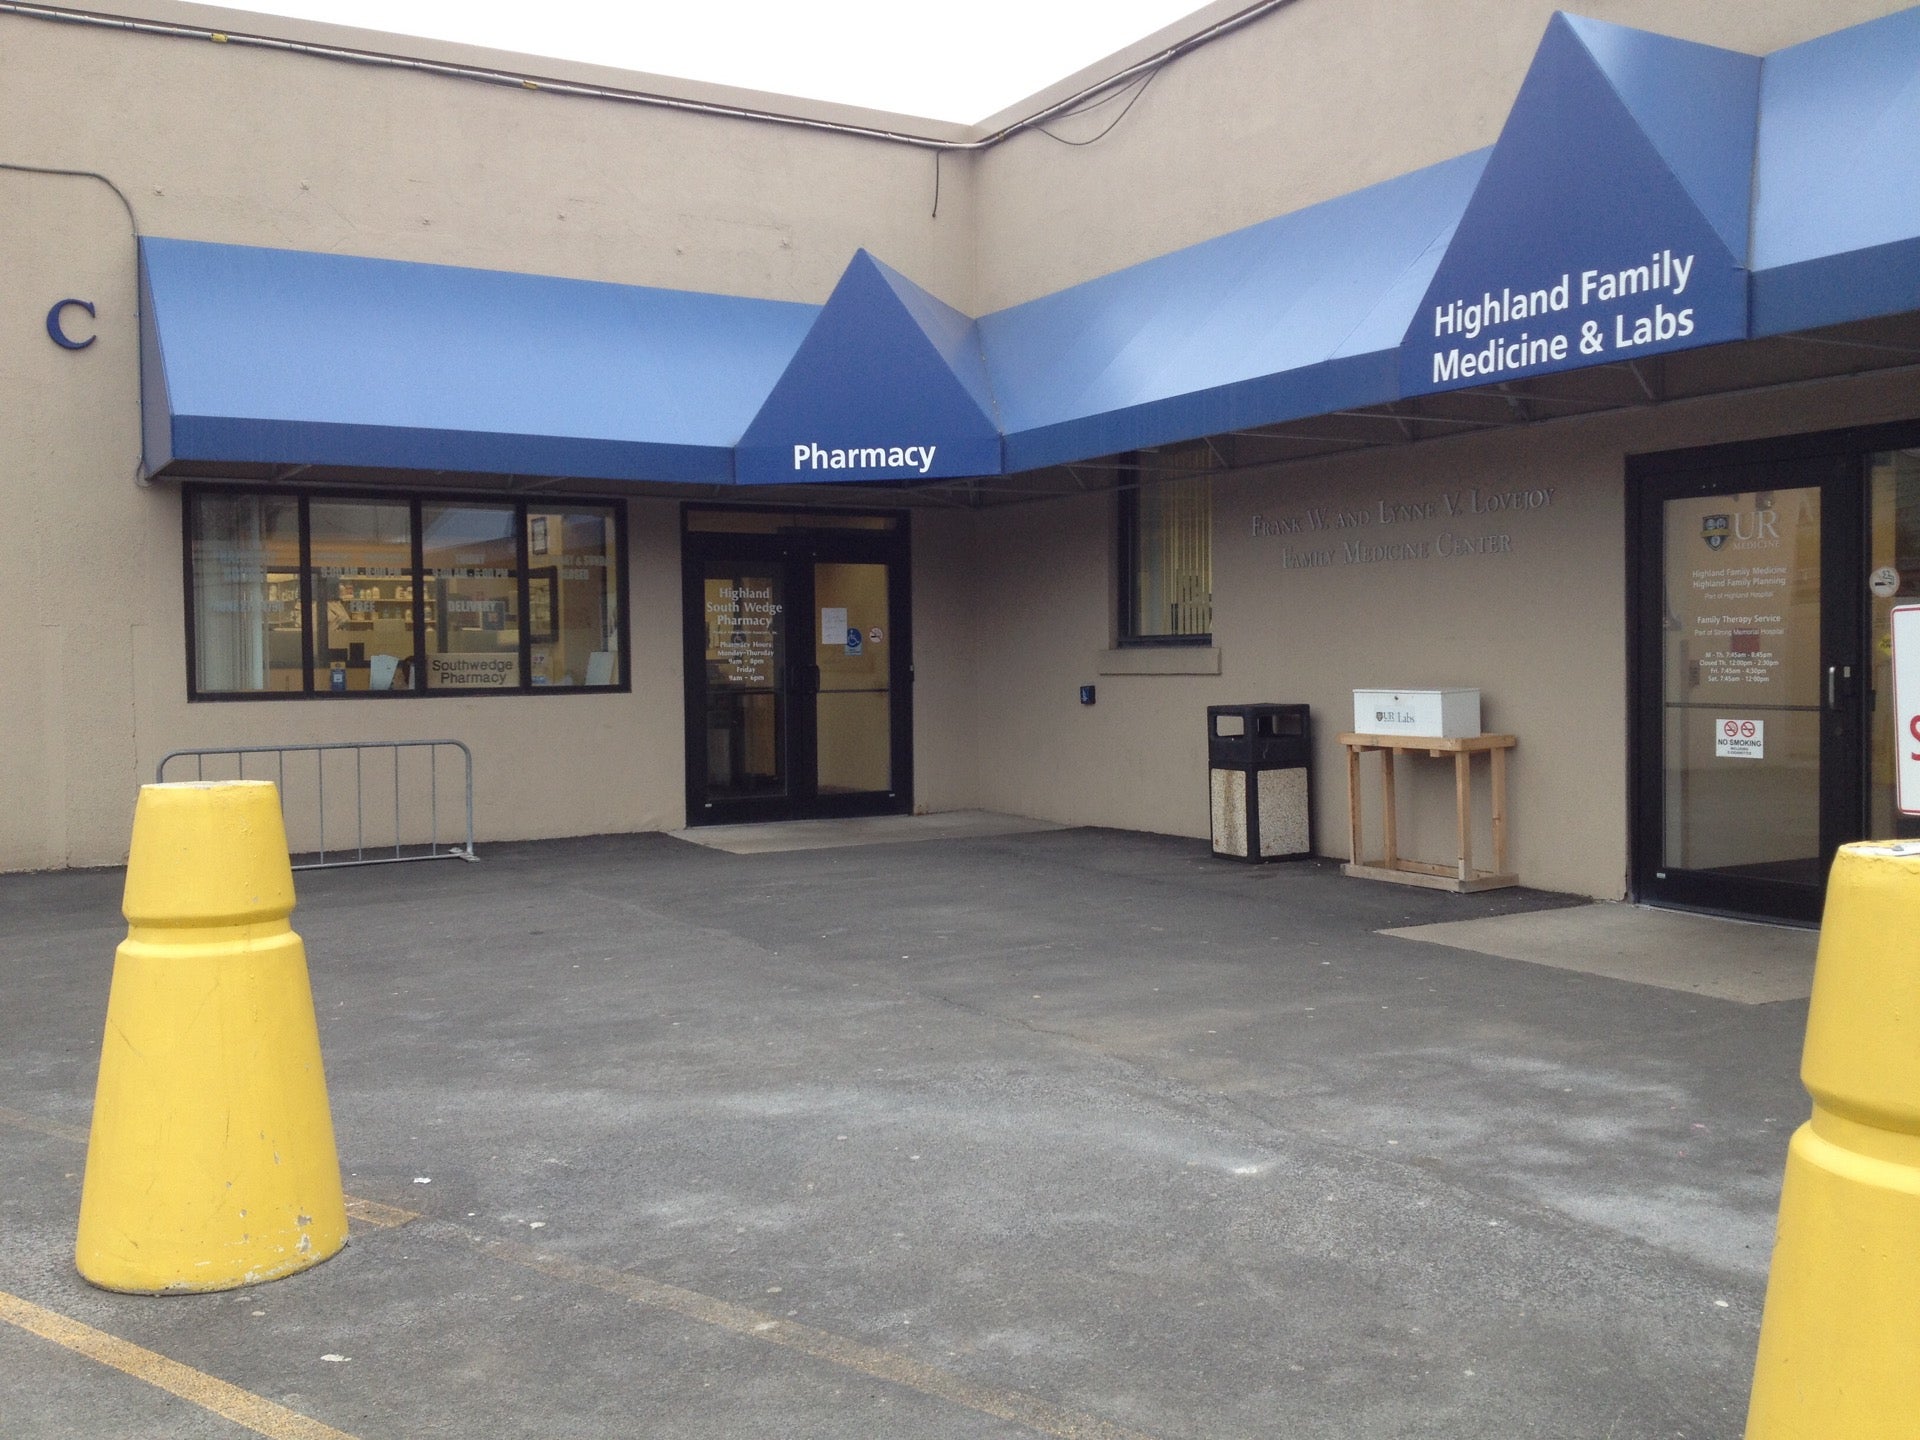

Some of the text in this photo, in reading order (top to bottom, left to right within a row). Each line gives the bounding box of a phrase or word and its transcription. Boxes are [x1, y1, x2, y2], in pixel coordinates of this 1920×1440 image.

[1434, 250, 1694, 339] Highland Family
[46, 299, 96, 350] C
[1433, 304, 1694, 383] Medicine & Labs
[794, 443, 936, 473] Pharmacy
[1734, 510, 1779, 540] UR
[1726, 568, 1750, 577] Family
[1693, 579, 1725, 589] Highland
[1727, 579, 1751, 587] Family
[719, 587, 770, 601] Highland
[448, 601, 496, 612] DELIVERY
[706, 601, 783, 616] South Wedge
[717, 615, 773, 628] Pharmacy
[1697, 616, 1720, 624] Family
[1722, 615, 1752, 624] Therapy
[432, 658, 513, 673] Southwedge
[736, 666, 755, 674] Friday
[440, 672, 507, 684] Pharmacy
[1383, 712, 1415, 723] UR Labs
[1730, 739, 1762, 747] SMOKING
